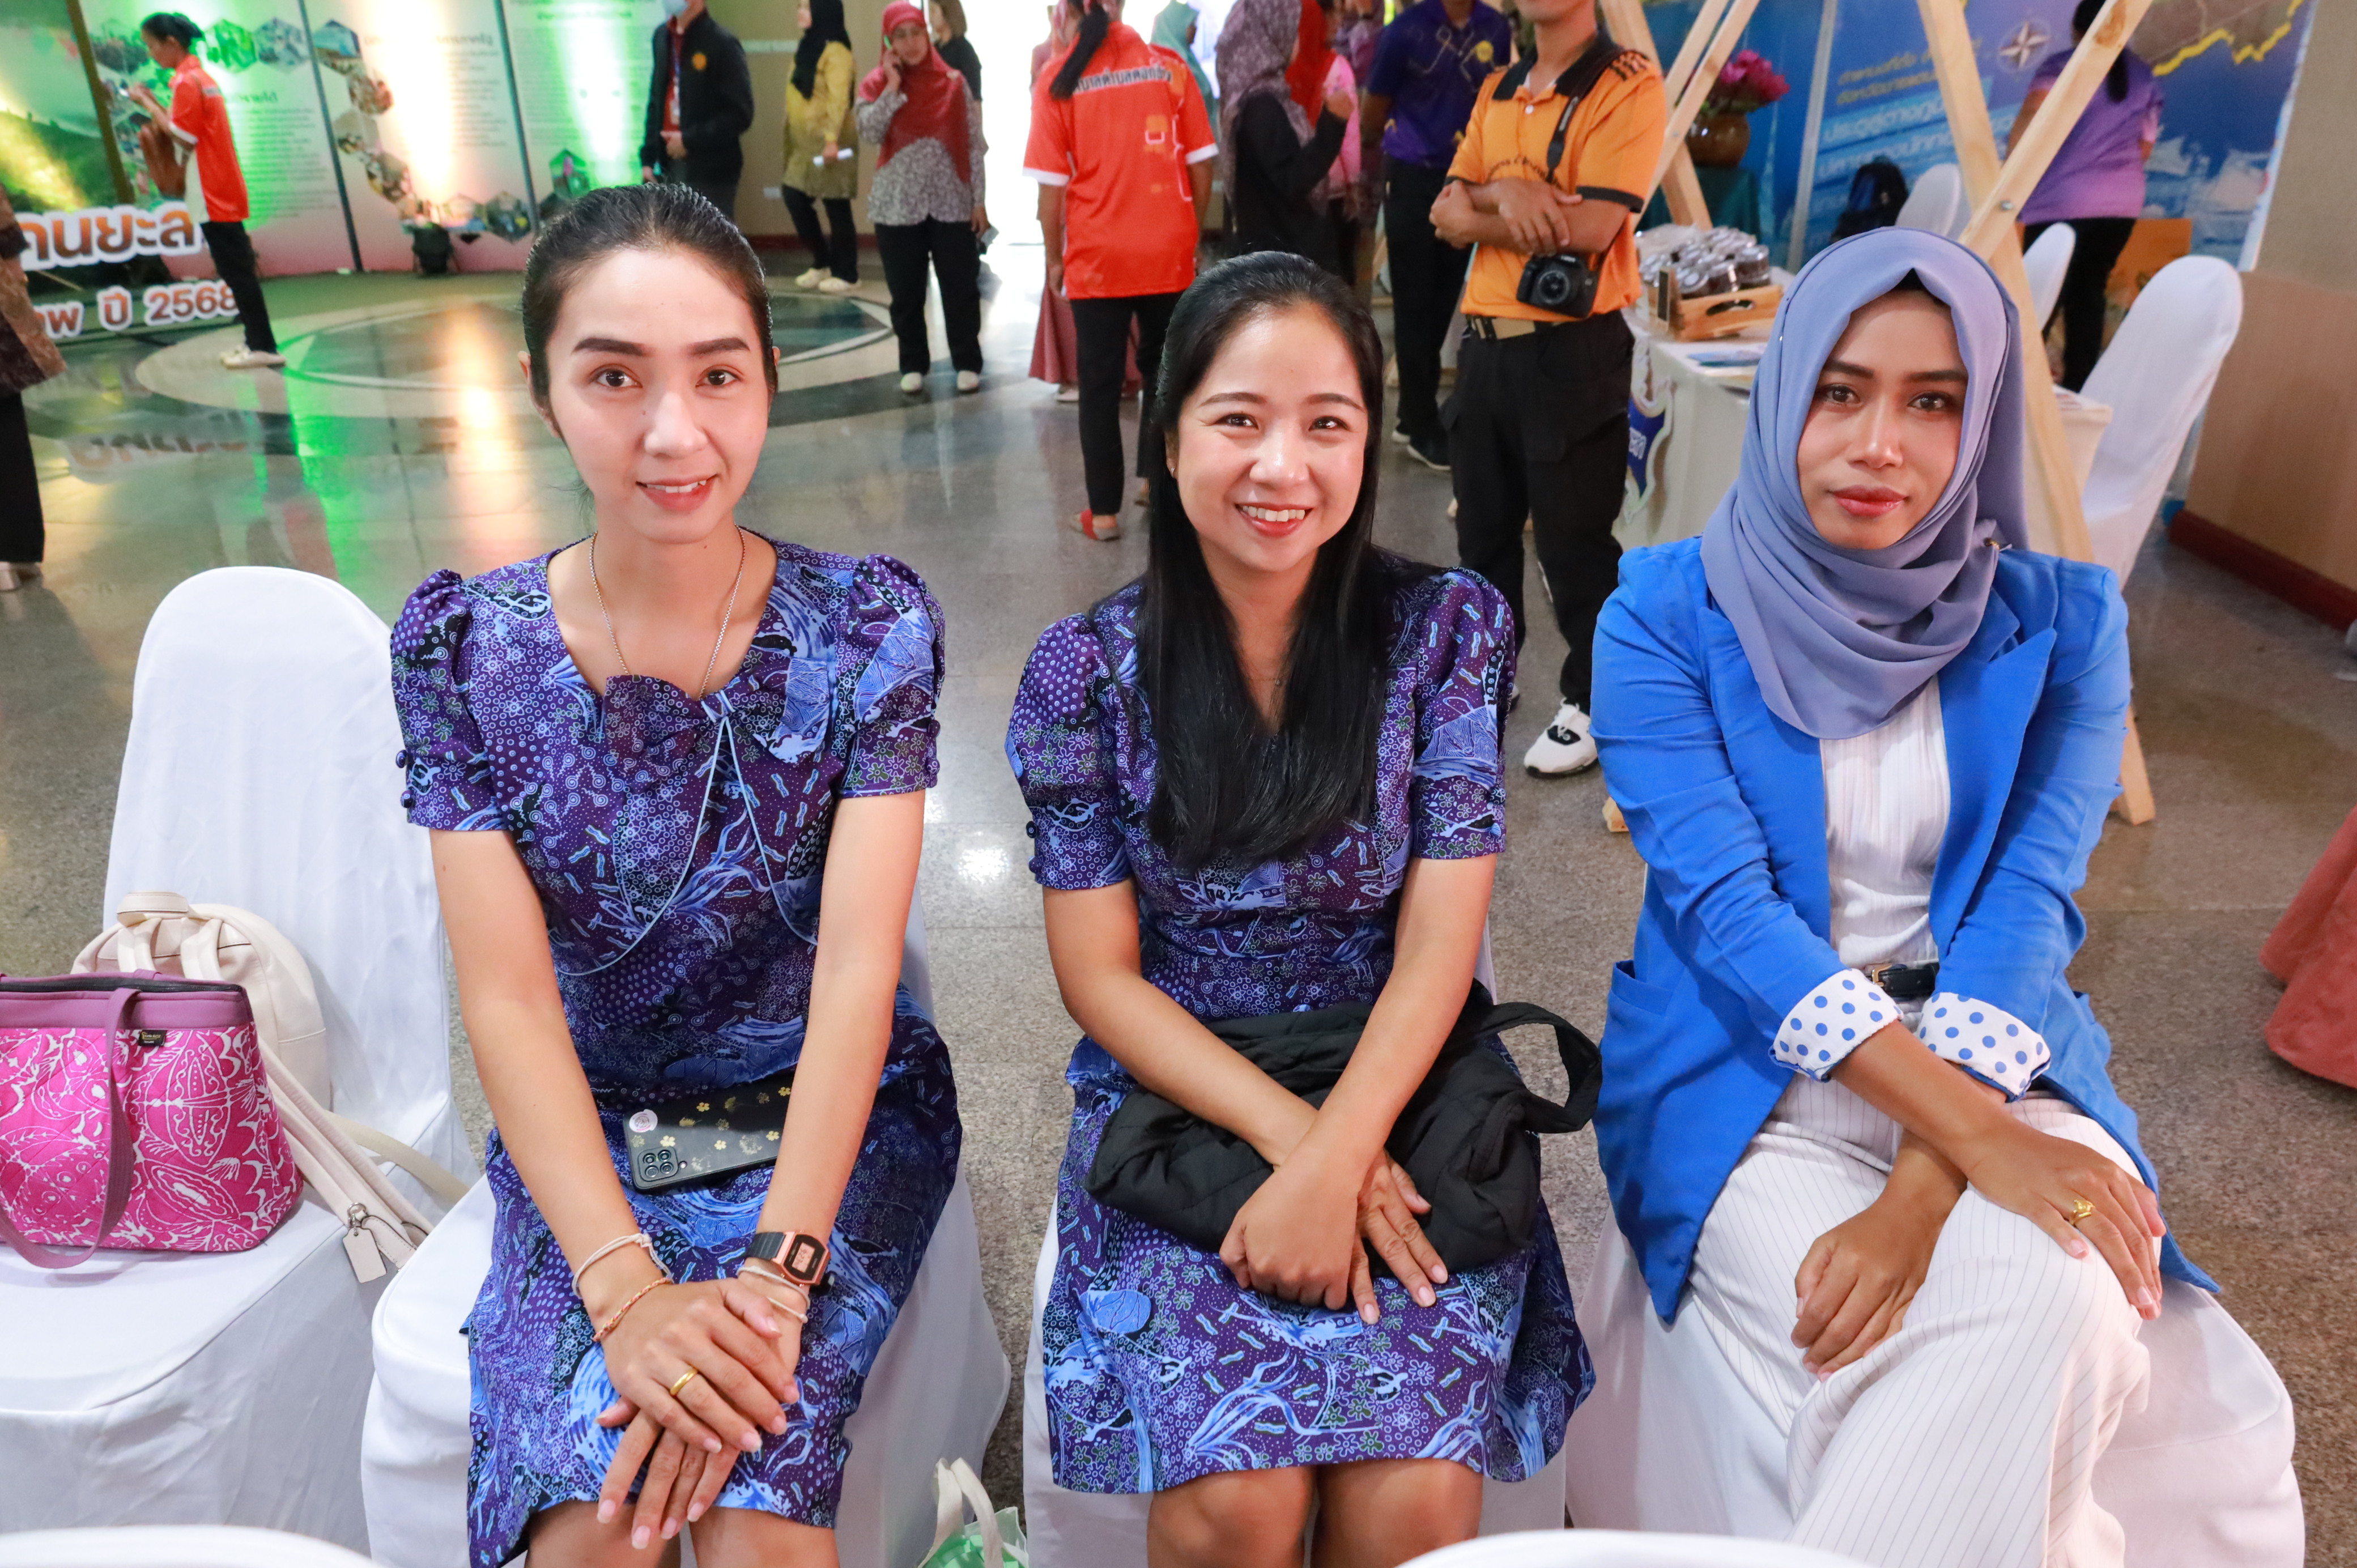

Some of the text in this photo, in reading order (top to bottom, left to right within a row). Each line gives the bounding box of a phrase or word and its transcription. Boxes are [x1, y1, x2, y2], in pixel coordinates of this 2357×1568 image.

[35, 284, 237, 333] พ ปี 2568
